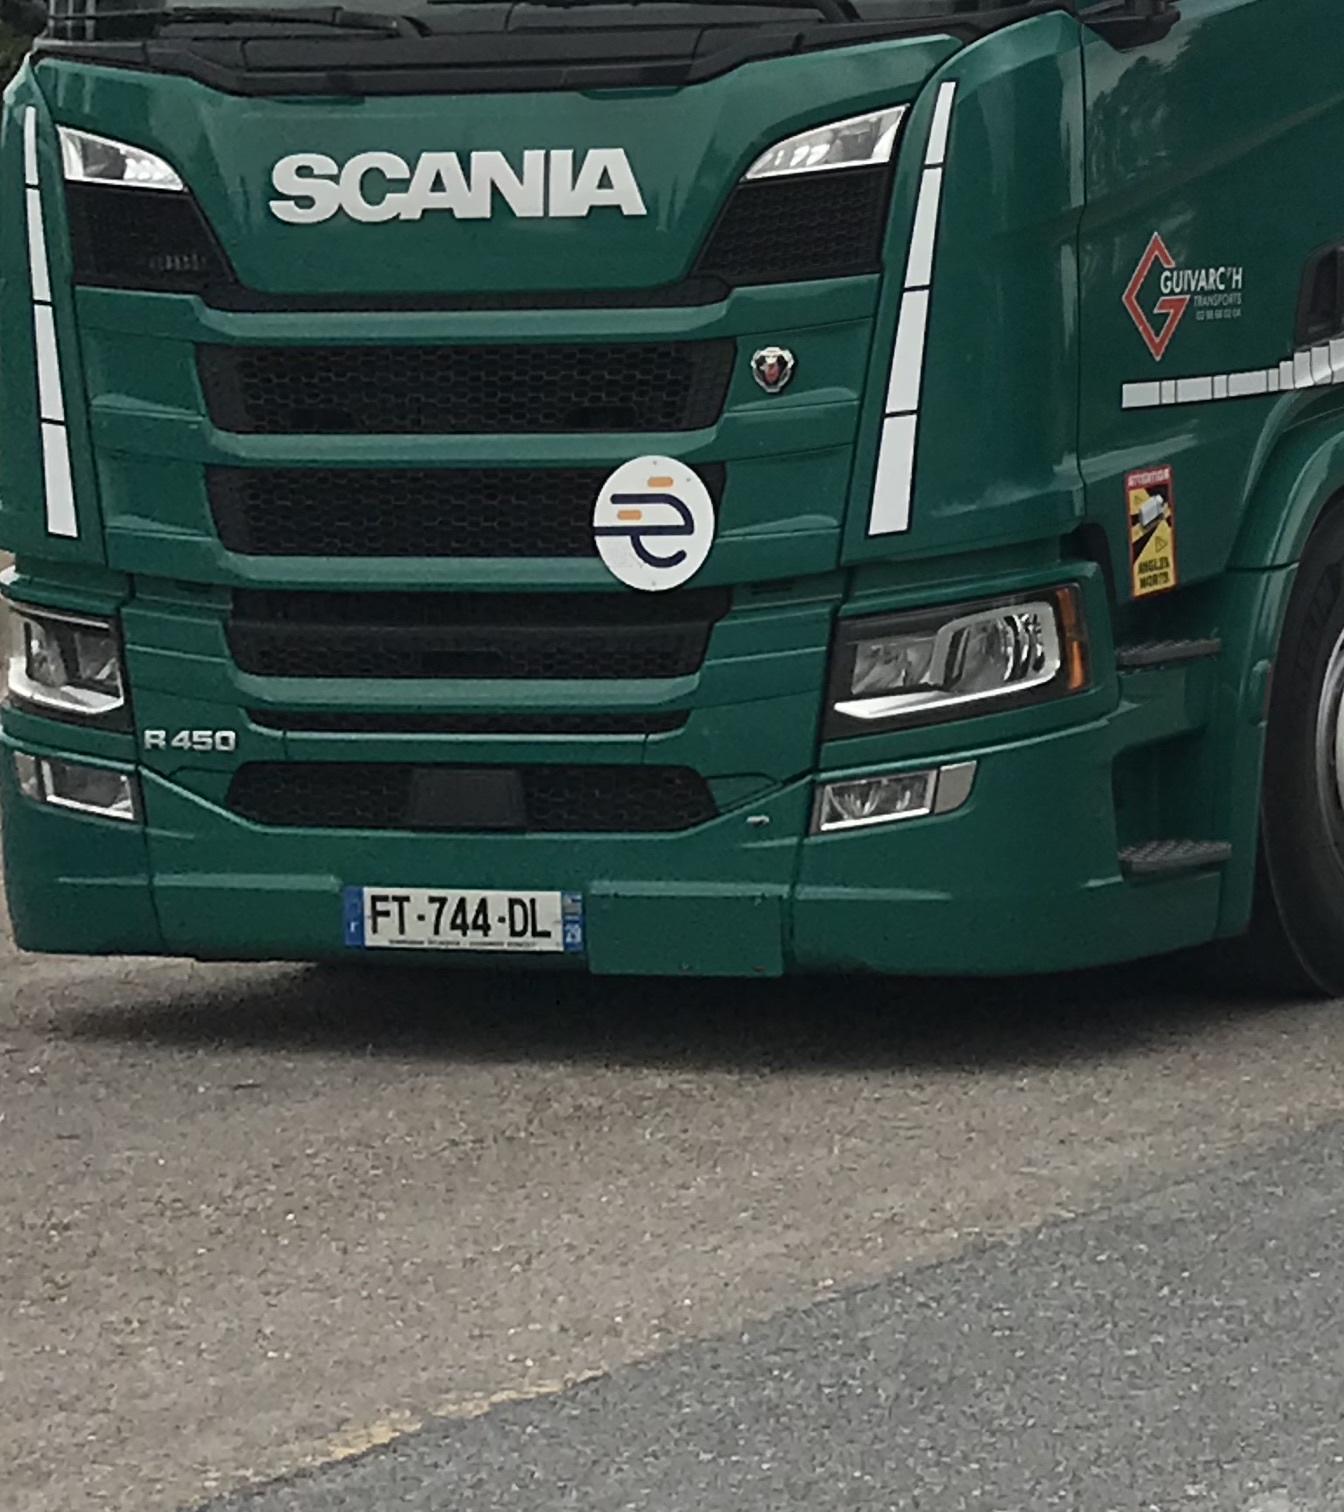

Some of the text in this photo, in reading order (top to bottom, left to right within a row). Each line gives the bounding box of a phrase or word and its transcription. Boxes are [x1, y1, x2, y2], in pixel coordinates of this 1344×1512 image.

[268, 148, 648, 224] SCANIA
[1160, 266, 1243, 294] GUIVARC'H
[1193, 292, 1242, 308] TRANSPORTS
[143, 729, 237, 752] R 450
